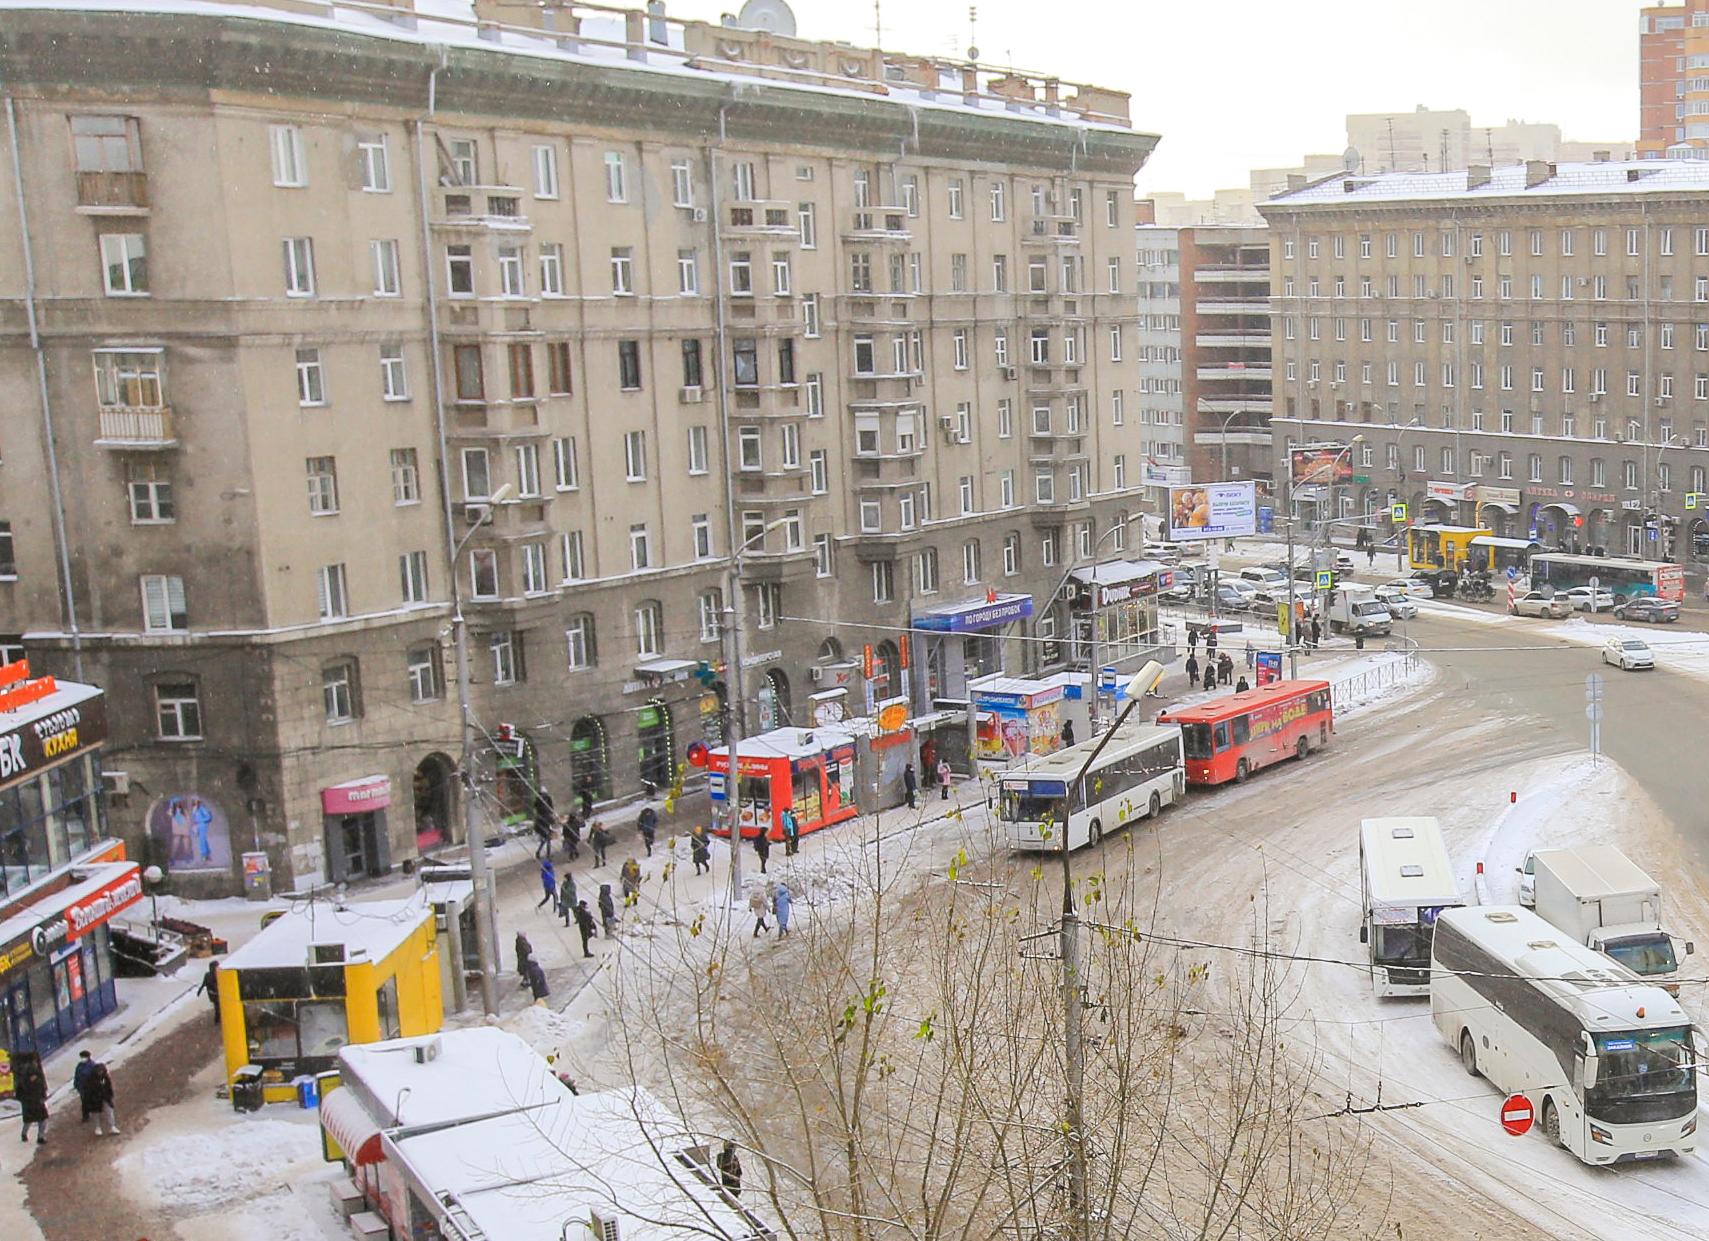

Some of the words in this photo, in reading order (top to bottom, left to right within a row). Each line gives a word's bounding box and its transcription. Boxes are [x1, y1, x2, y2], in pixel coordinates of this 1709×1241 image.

[965, 614, 973, 625] ПО
[972, 611, 992, 624] ГОРОДУ
[993, 609, 1001, 619] БЕЗ
[1002, 604, 1021, 617] ПРОБОК
[41, 727, 79, 758] КУХНЯ
